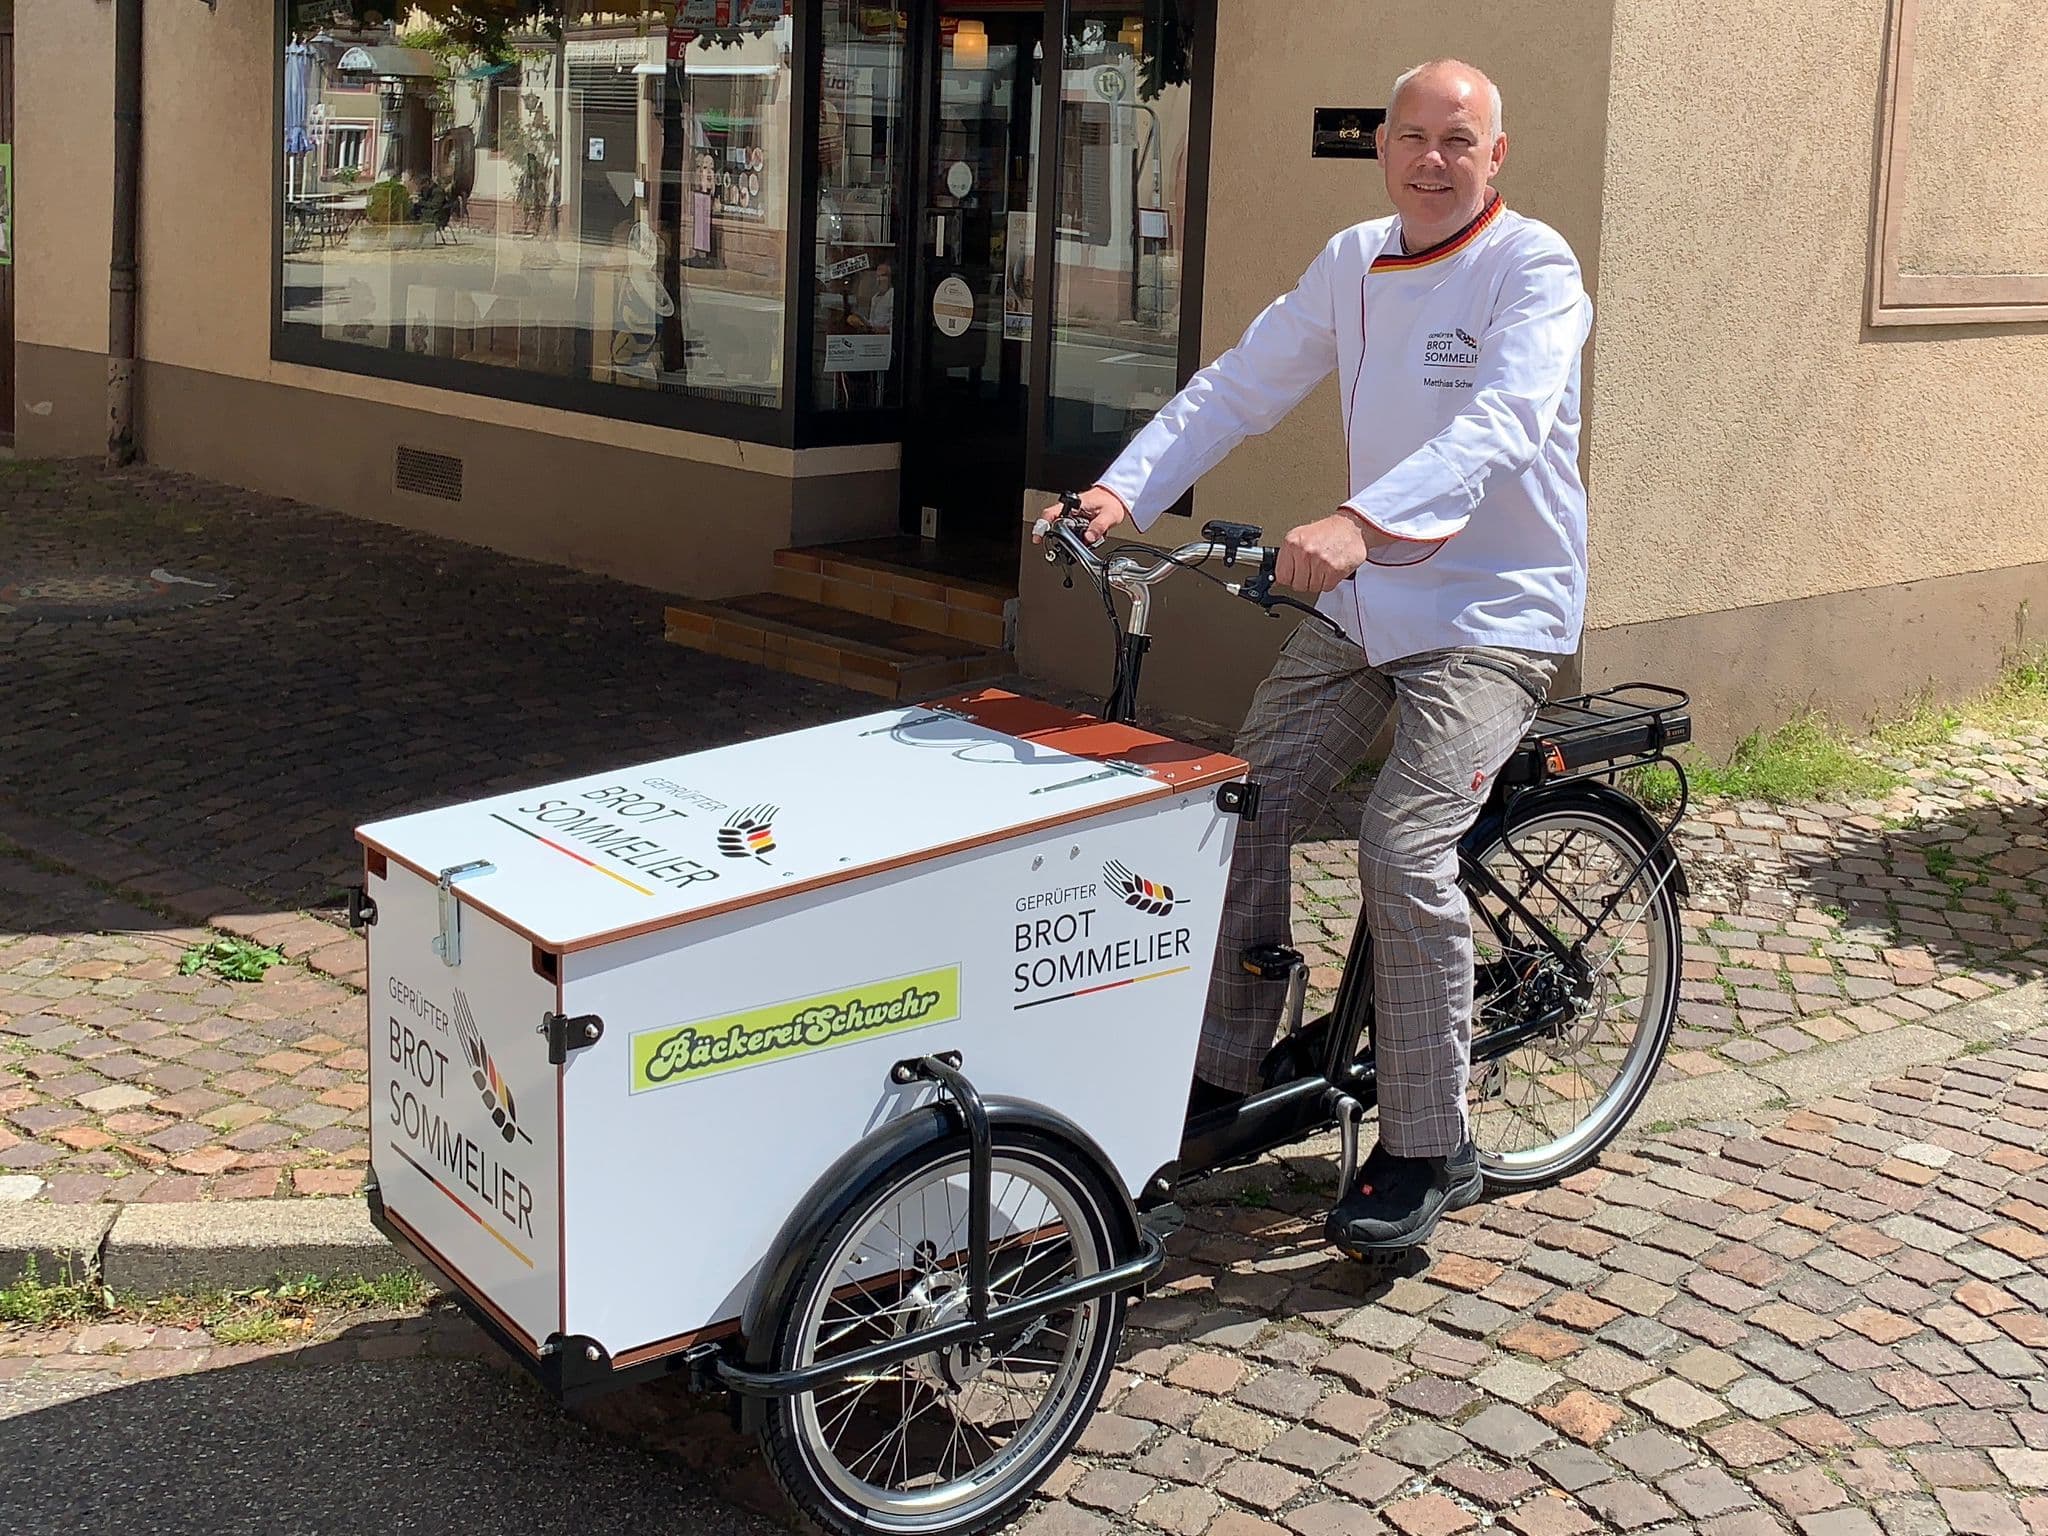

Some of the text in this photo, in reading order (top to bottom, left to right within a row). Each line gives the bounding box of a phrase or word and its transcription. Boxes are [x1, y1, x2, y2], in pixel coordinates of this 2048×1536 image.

[1424, 352, 1479, 364] SOMMELIE
[1426, 340, 1453, 350] BROT
[1423, 377, 1454, 388] Matthias
[579, 785, 689, 824] BROT
[641, 776, 728, 813] GEPRÜFTER
[517, 799, 721, 889] SOMMELIER
[1015, 883, 1097, 912] GEPRÜFTER
[1015, 909, 1096, 953] BROT
[1014, 927, 1191, 993] SOMMELIER
[388, 975, 449, 1038] GEPRÜFTER
[389, 1015, 449, 1100] BROT
[390, 1079, 534, 1240] SOMMELIER
